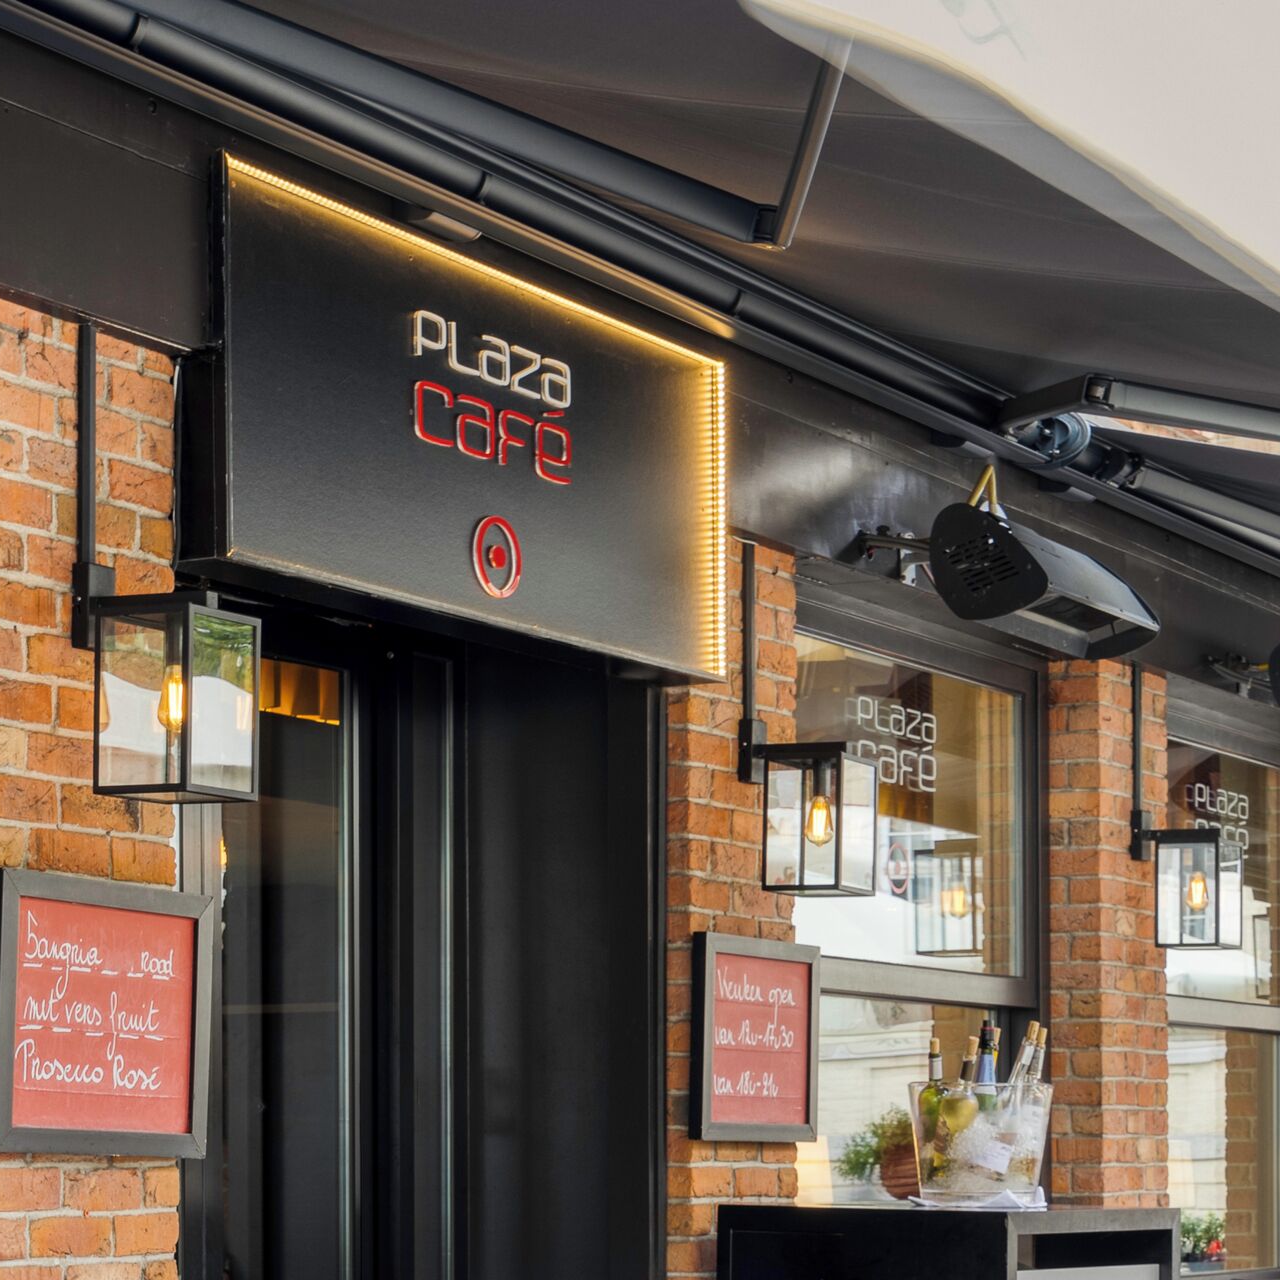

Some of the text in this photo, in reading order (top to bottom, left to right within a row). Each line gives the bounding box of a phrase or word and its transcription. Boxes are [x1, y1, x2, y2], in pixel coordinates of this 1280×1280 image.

[24, 910, 103, 999] Sangria
[64, 1001, 103, 1026] vers
[106, 991, 160, 1060] fruit
[768, 986, 797, 1027] open
[14, 1038, 162, 1091] Prosecco Rosé
